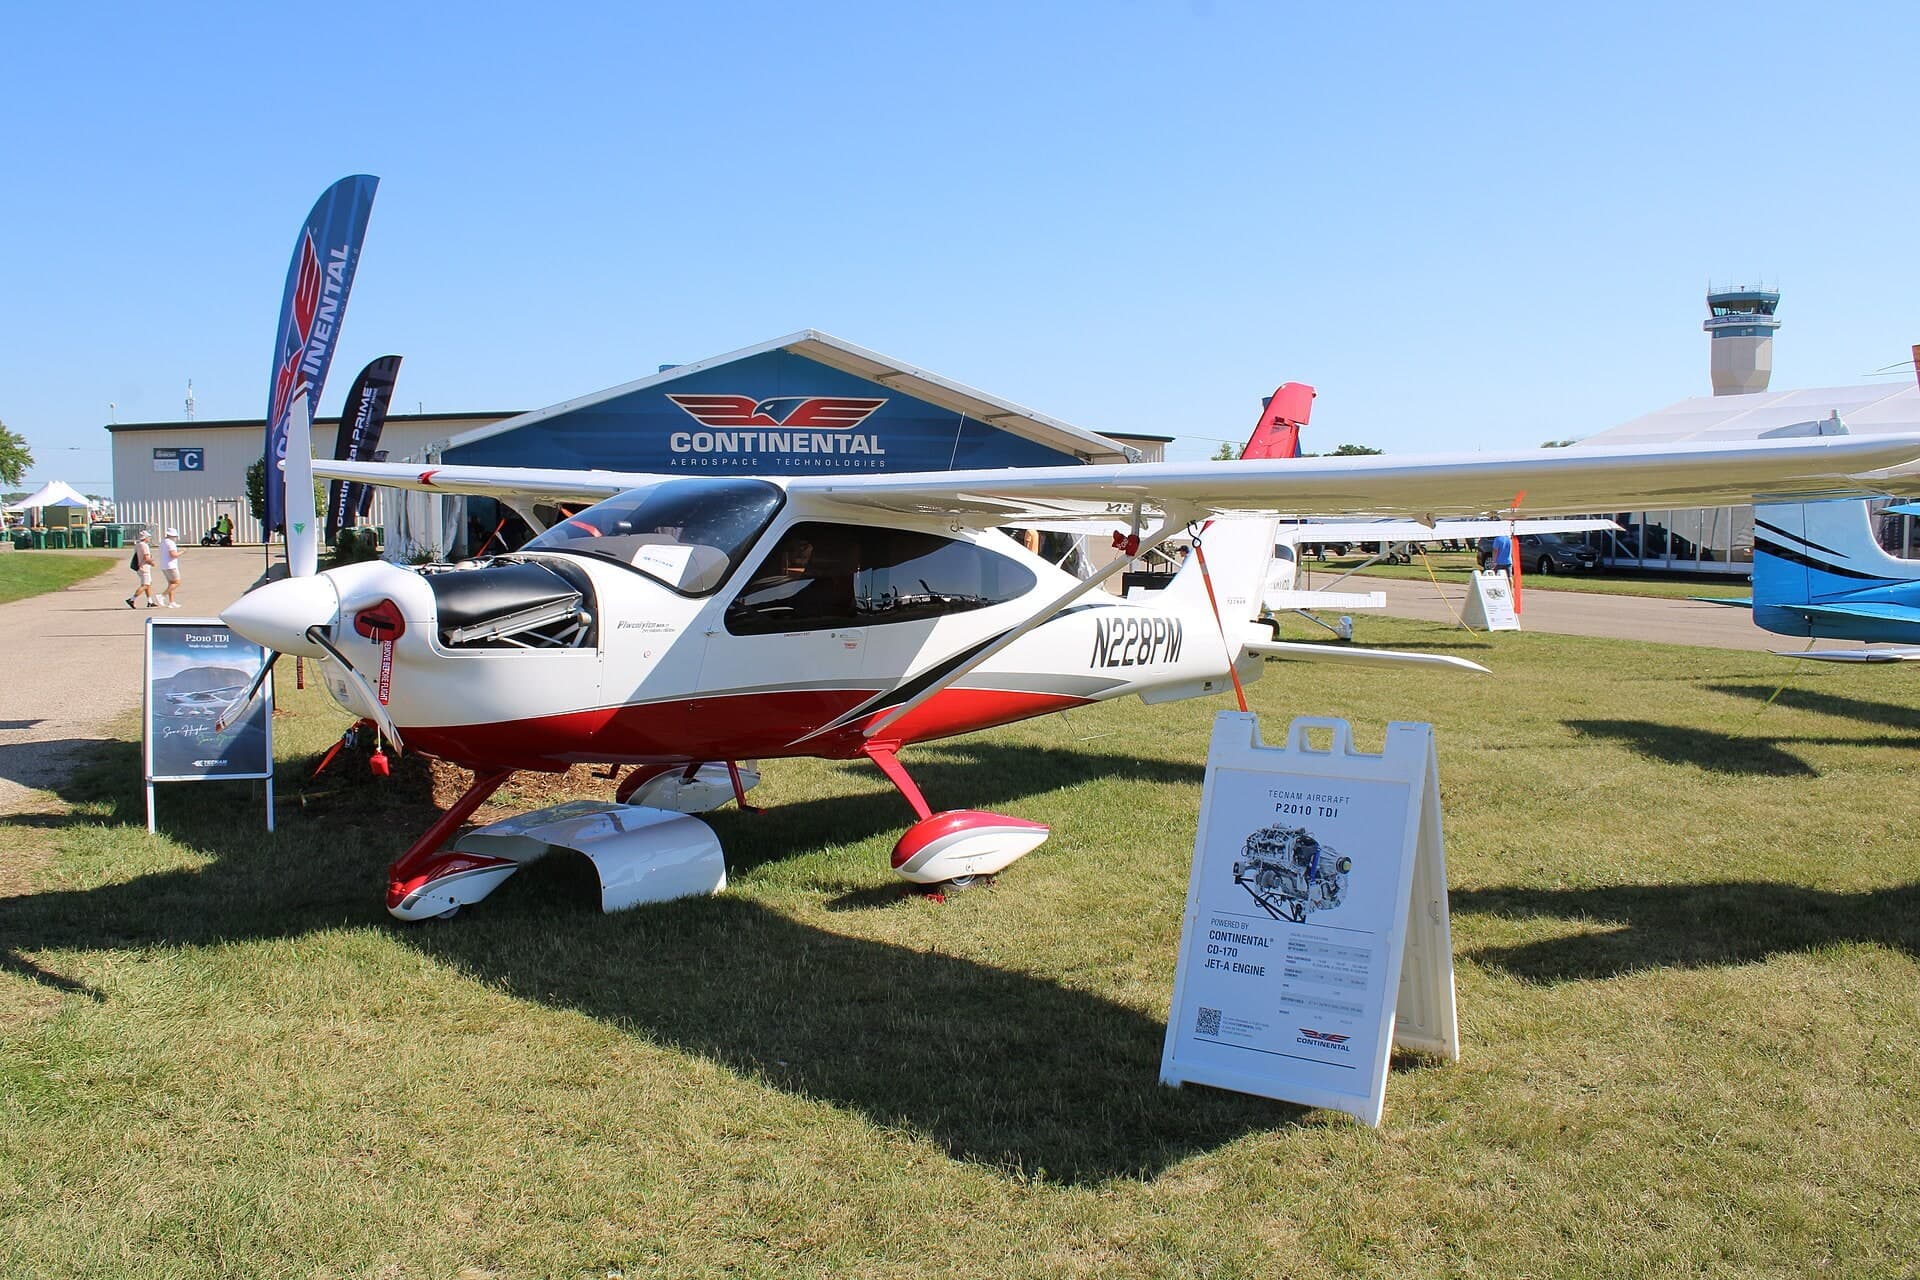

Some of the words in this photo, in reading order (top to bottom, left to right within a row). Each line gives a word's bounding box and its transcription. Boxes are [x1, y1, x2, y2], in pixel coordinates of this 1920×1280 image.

[670, 432, 885, 455] CONTINENTAL
[184, 453, 199, 469] C
[671, 458, 758, 466] AEROSPACE
[776, 458, 885, 467] TECHNOLOGIES
[185, 634, 211, 642] P2010
[212, 634, 230, 643] TDI
[1090, 617, 1183, 668] N228PM
[382, 640, 392, 661] REMOVE
[381, 662, 391, 682] BEFORE
[380, 682, 389, 701] FLIGHT
[1268, 790, 1303, 800] TECNAM
[1306, 793, 1351, 804] AIRCRAFT
[1275, 803, 1312, 816] P2010
[1318, 806, 1338, 818] TDI
[1210, 918, 1240, 929] POWERED
[1240, 923, 1249, 931] BY
[1207, 944, 1238, 958] CD-170
[1204, 959, 1230, 971] JET-A
[1232, 962, 1266, 977] ENGINE
[1296, 1037, 1351, 1052] CONTINENTAL
